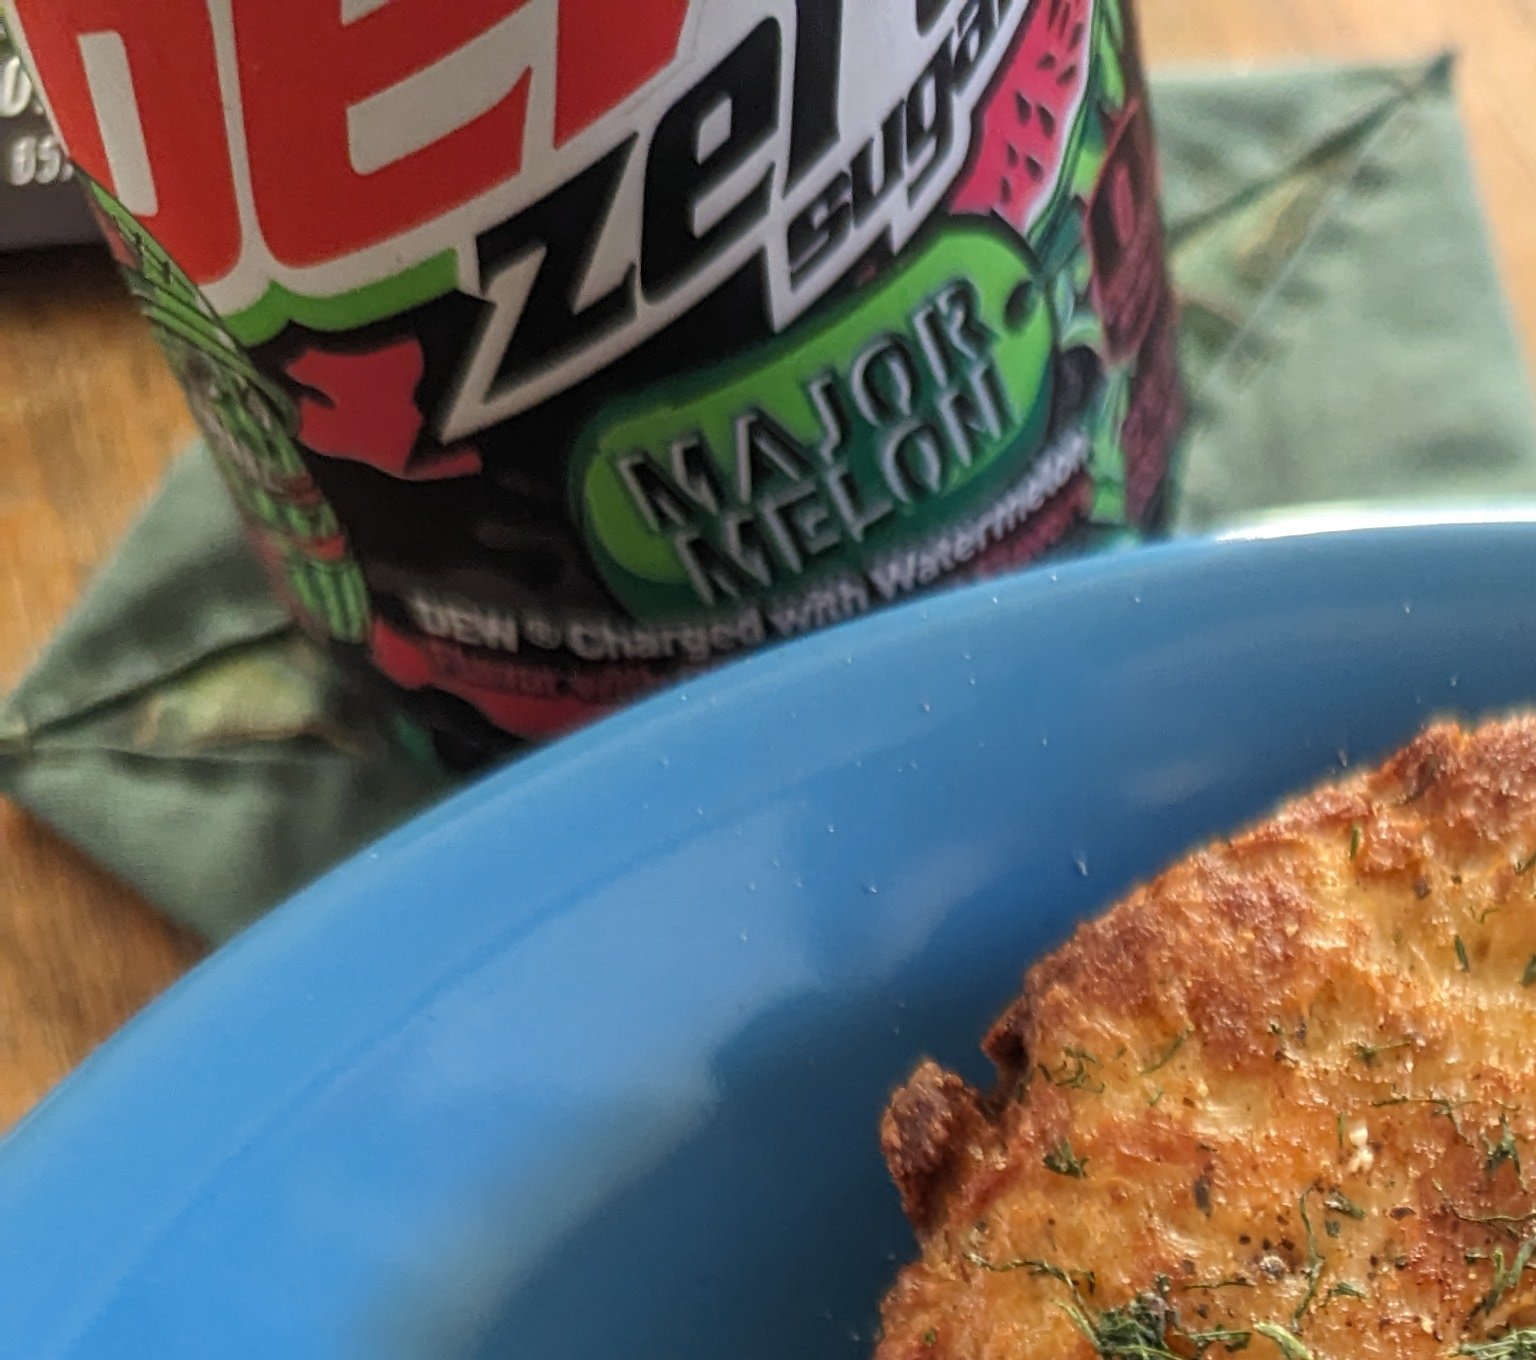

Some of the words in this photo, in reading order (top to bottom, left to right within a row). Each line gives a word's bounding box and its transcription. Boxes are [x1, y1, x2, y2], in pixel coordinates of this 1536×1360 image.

[616, 276, 1000, 534] MAJOR
[675, 355, 1021, 606] MELON
[566, 605, 766, 662] Charged
[769, 580, 869, 637] with
[870, 429, 1089, 599] Watermelon
